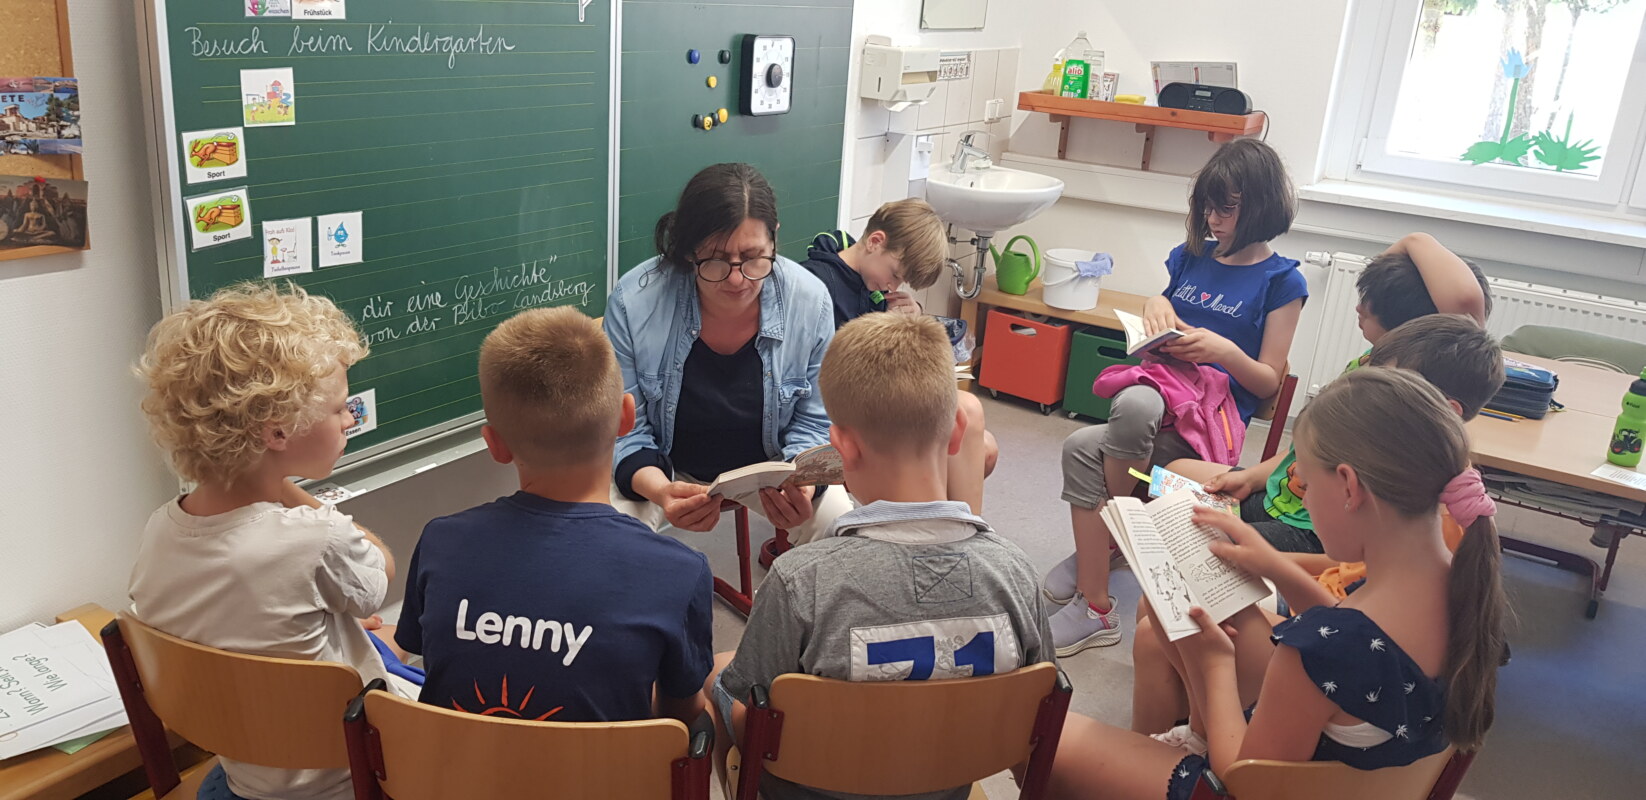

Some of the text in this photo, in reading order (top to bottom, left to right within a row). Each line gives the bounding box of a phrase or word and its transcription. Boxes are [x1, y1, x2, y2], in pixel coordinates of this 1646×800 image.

[184, 17, 516, 69] Besuch beim Kindergarten
[1, 94, 25, 103] ETE
[207, 170, 226, 179] Sport
[212, 232, 231, 242] Sport
[361, 295, 394, 322] dir
[406, 280, 448, 313] eine
[1172, 279, 1200, 305] Little
[361, 327, 401, 345] von
[406, 314, 441, 335] der
[512, 279, 596, 307] Landsberg
[345, 427, 362, 436] Essen
[456, 598, 594, 667] Lenny
[12, 653, 68, 692] Wie lange?
[6, 687, 49, 716] Wann?
